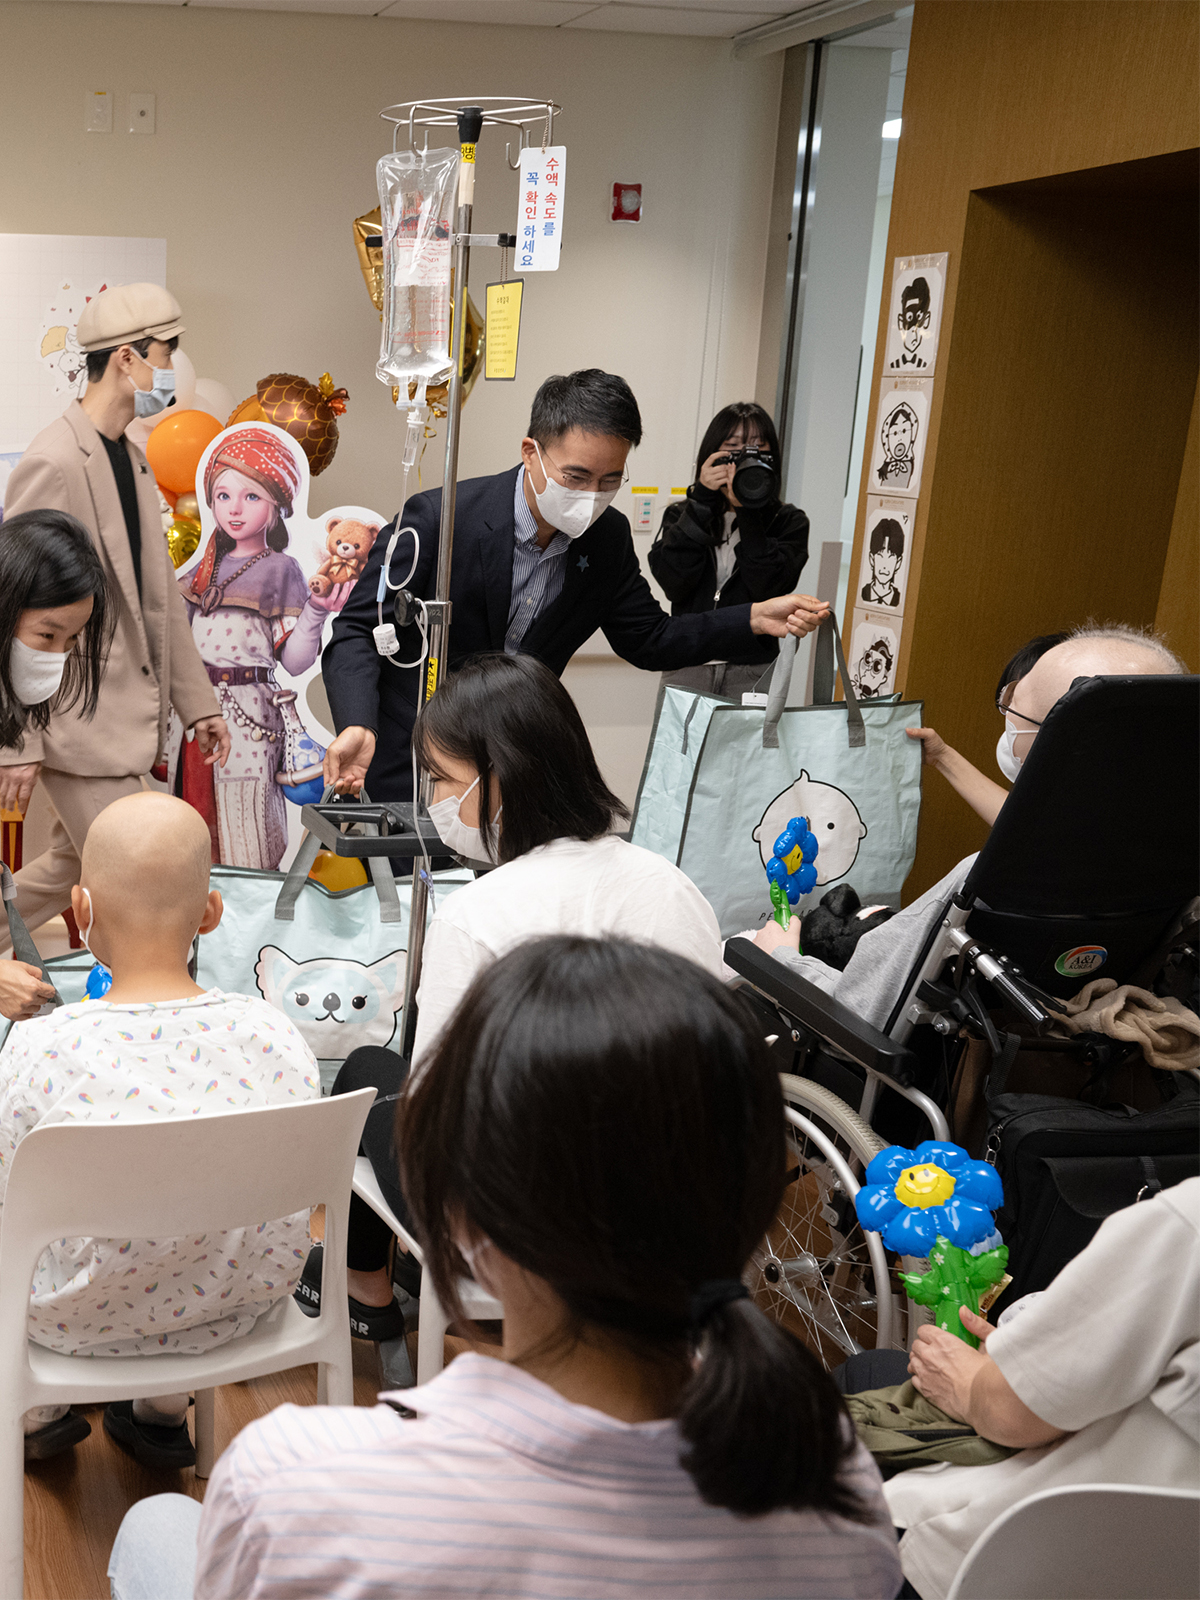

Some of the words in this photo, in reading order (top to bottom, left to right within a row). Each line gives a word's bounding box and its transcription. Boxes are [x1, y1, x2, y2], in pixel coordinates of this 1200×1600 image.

[526, 172, 539, 186] 꼭
[545, 156, 559, 187] 수액
[542, 191, 558, 237] 속도를
[1071, 954, 1097, 965] A&I
